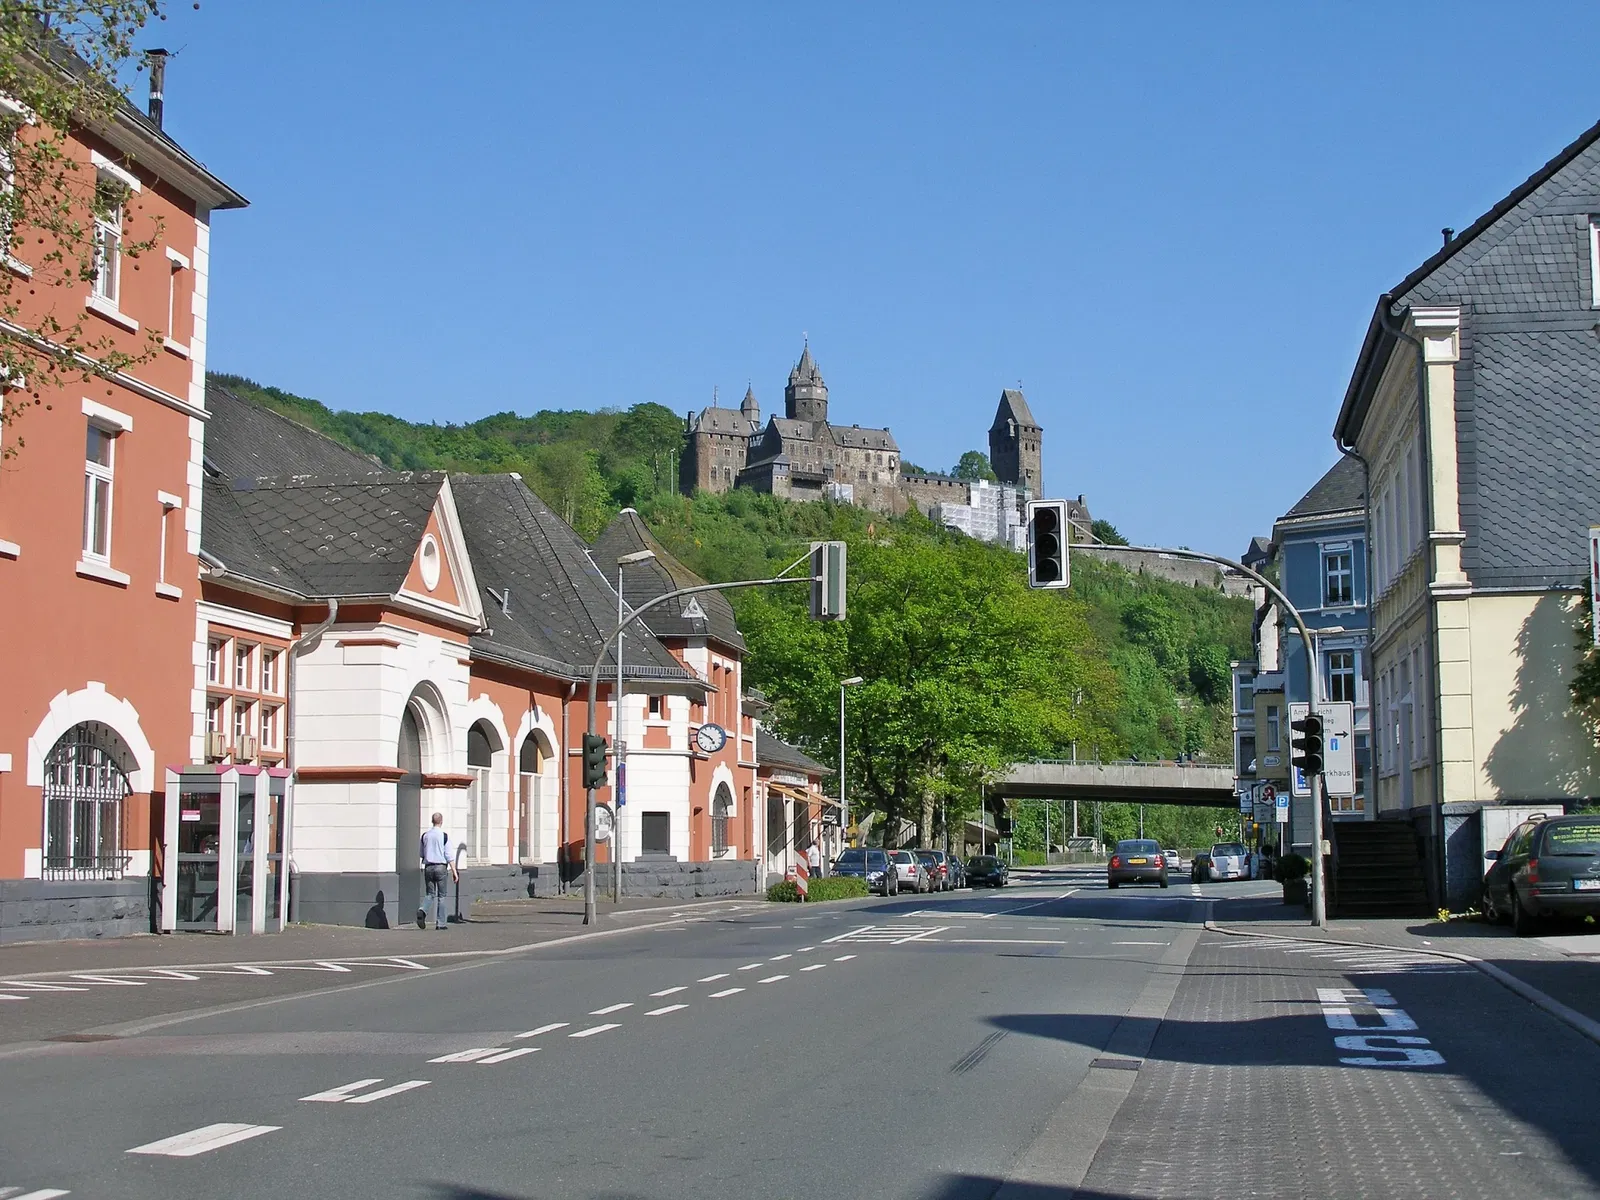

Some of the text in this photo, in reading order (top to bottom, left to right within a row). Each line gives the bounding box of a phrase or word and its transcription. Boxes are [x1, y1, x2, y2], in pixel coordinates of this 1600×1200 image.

[1293, 708, 1333, 716] Amtsricht
[1325, 769, 1351, 777] rkhaus
[1278, 797, 1287, 807] P
[1316, 988, 1446, 1066] BUS
